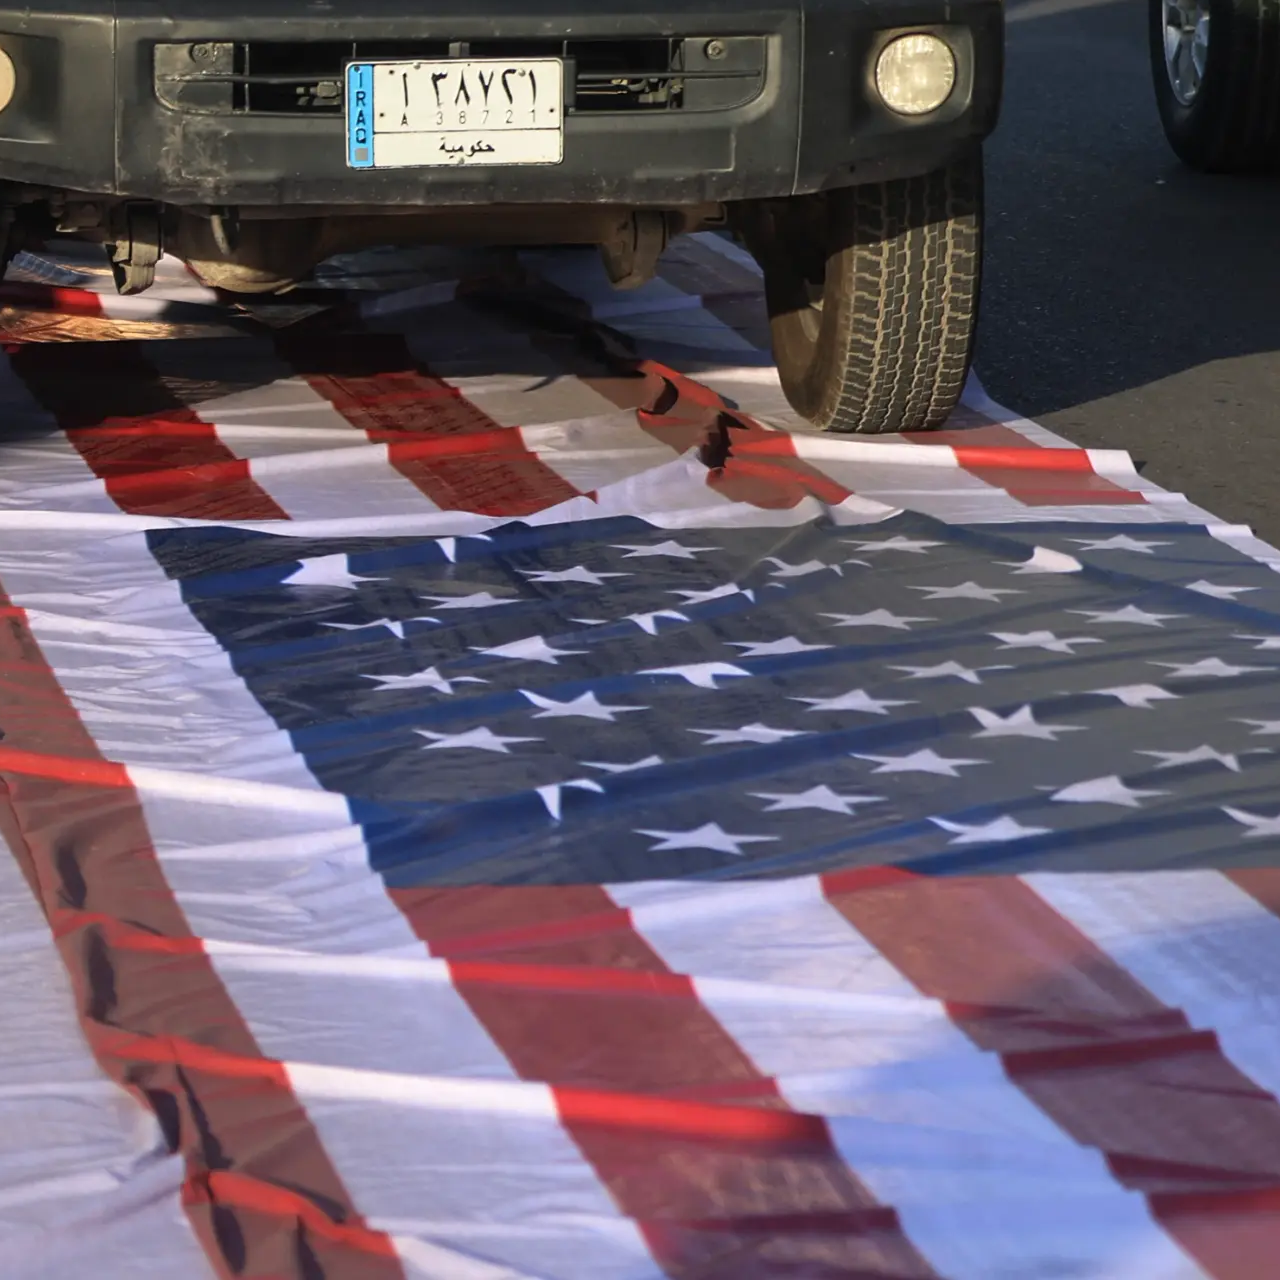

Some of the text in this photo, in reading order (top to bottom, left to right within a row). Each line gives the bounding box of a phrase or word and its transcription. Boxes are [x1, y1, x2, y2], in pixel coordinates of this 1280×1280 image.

[355, 71, 368, 145] IRAQ
[435, 108, 537, 126] 38721
[438, 136, 496, 160] حكومية
